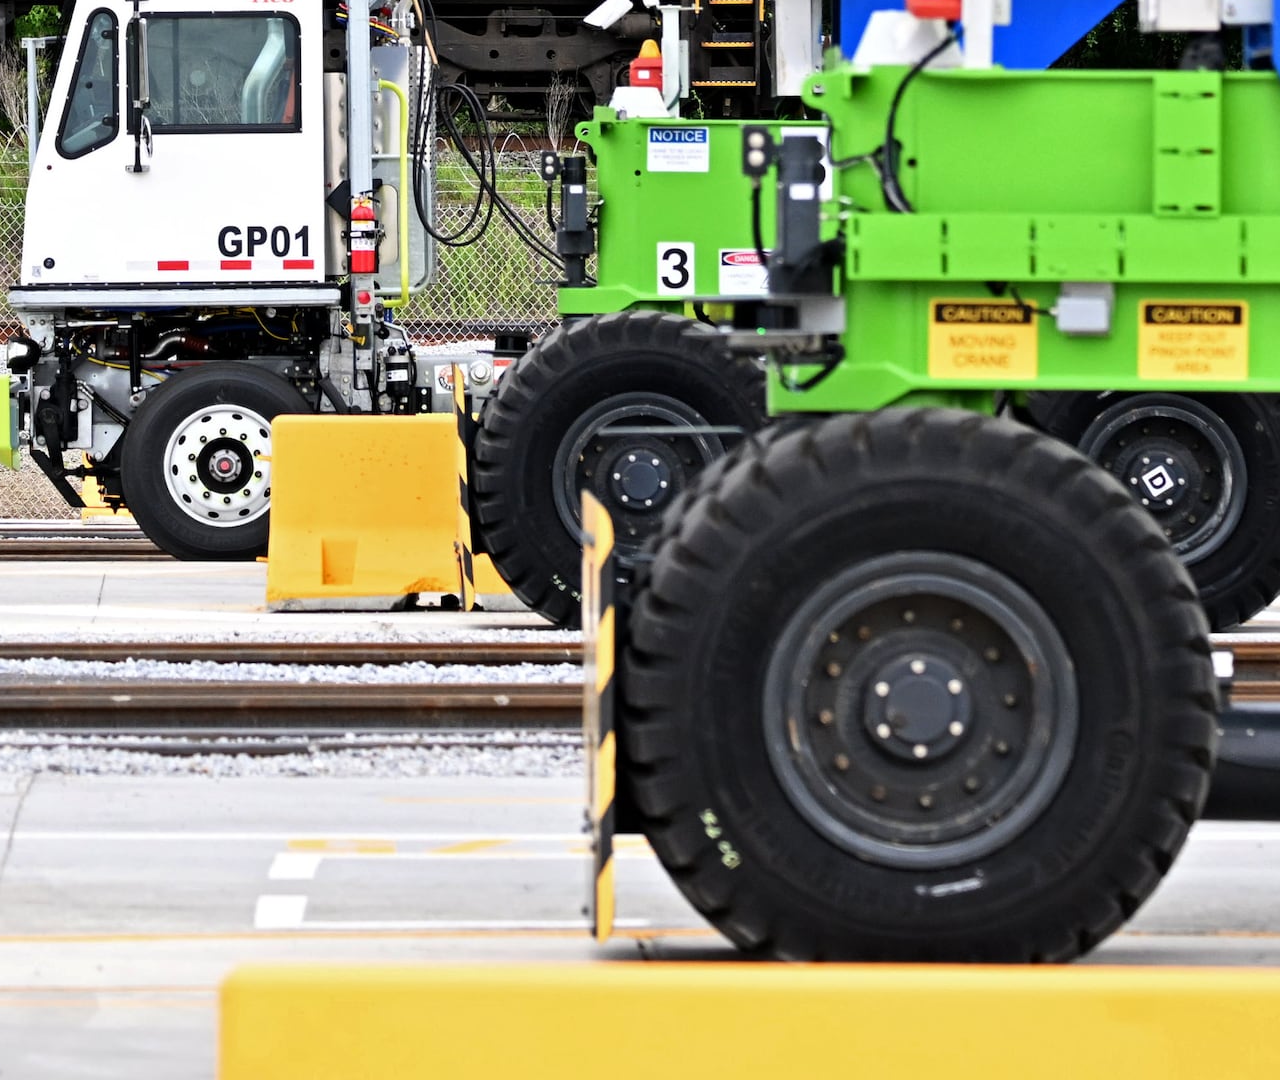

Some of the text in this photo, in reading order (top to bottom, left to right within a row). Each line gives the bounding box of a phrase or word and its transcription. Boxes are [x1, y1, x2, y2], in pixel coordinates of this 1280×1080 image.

[652, 130, 705, 142] NOTICE
[217, 225, 309, 258] GP01
[661, 248, 689, 289] 3
[942, 306, 1024, 321] CAUTION
[1151, 306, 1235, 323] CAUTION
[948, 333, 1017, 350] MOVING
[952, 351, 1011, 369] CRANE
[1148, 471, 1167, 490] D
